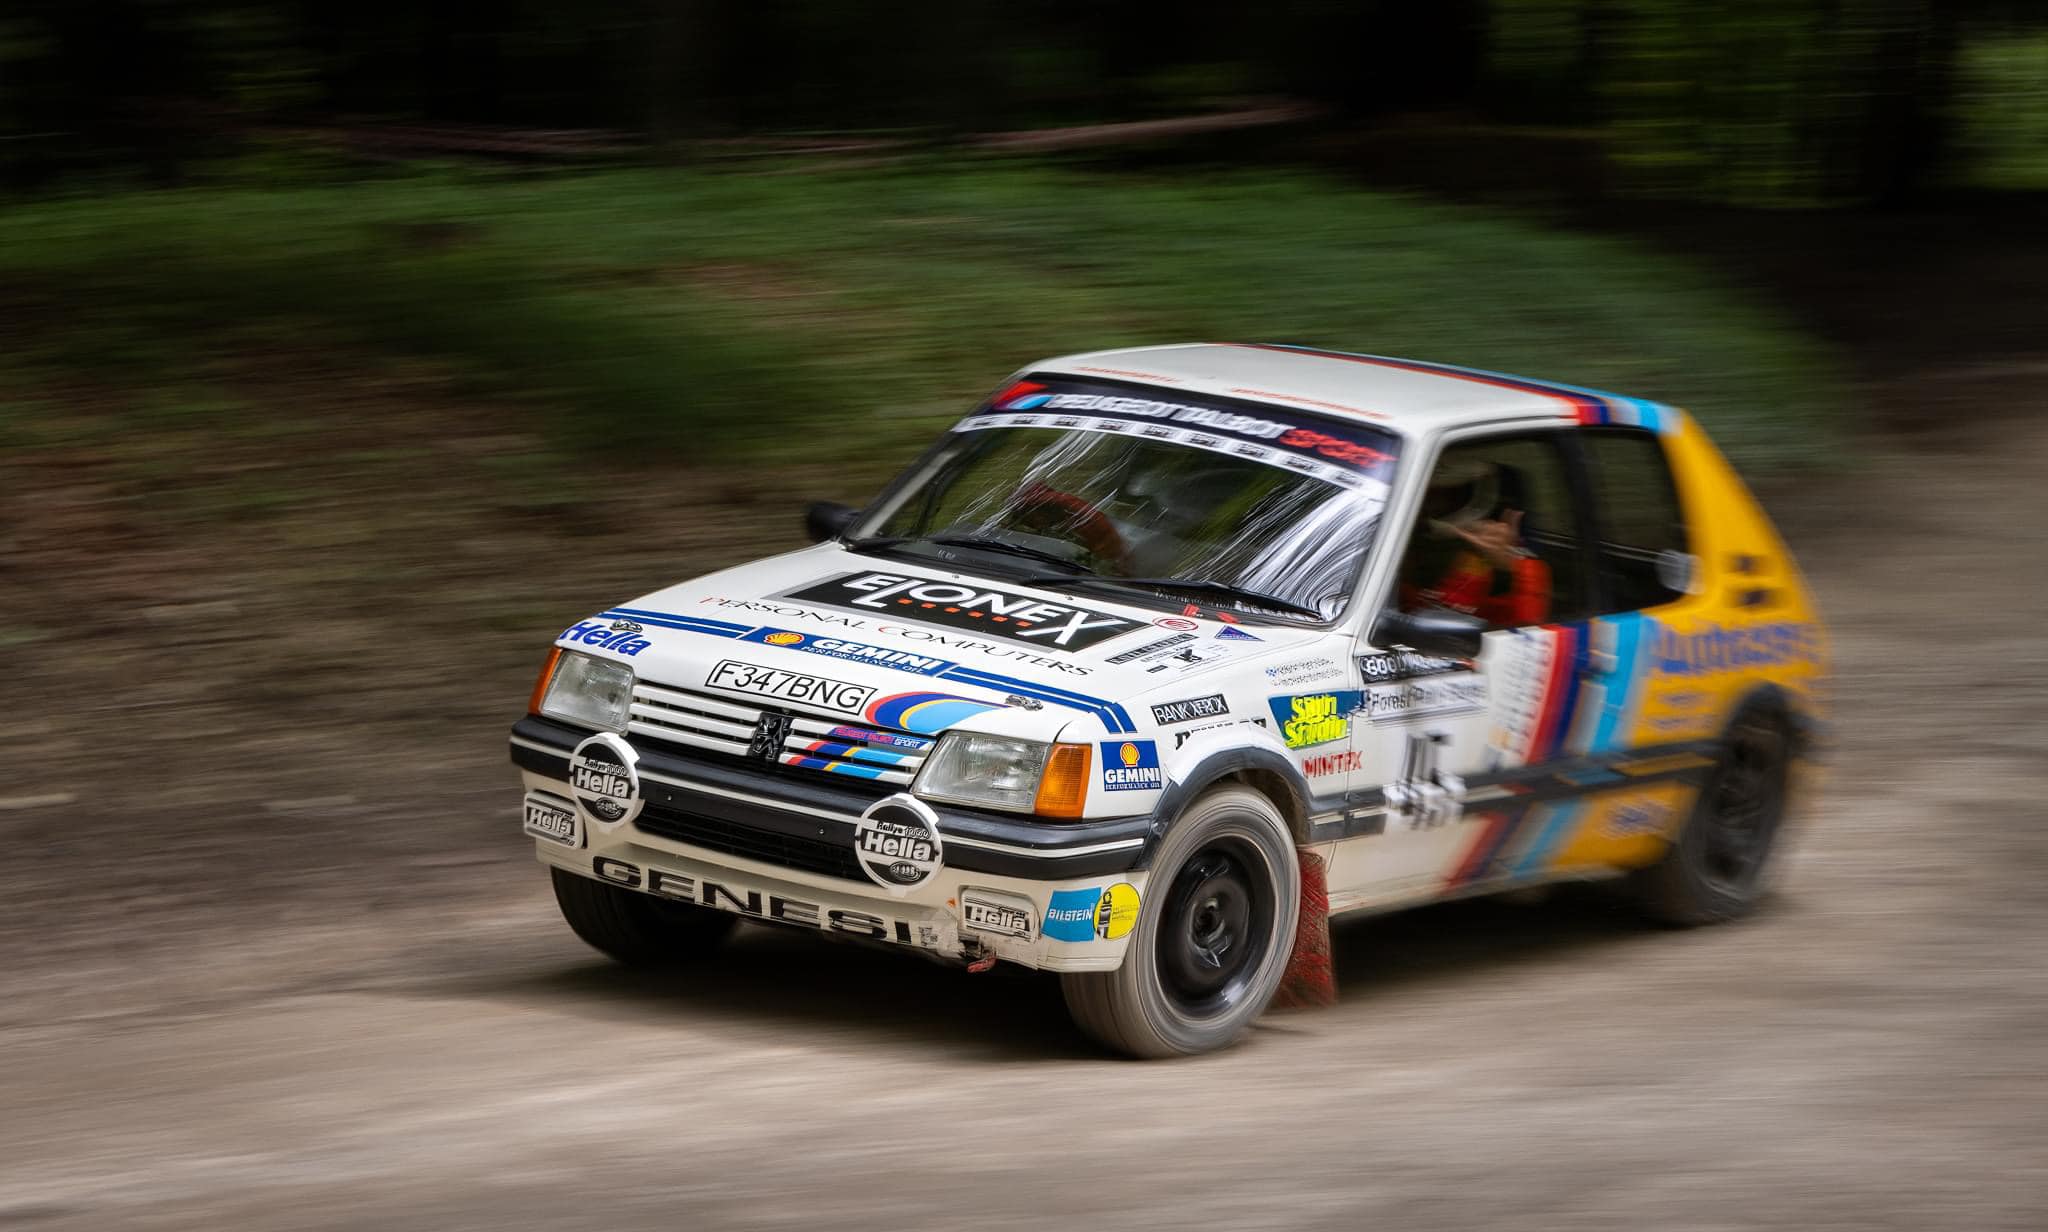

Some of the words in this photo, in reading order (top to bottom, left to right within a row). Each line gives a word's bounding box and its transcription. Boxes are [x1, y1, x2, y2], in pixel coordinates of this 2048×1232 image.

[559, 622, 652, 656] Hella
[699, 597, 867, 630] PERSONAL
[879, 626, 1094, 677] COMPUTERS
[801, 646, 899, 669] PERFORMANCE
[812, 638, 945, 670] GEMINI
[712, 662, 865, 708] F347BNG
[1154, 703, 1191, 722] RANK
[1189, 696, 1228, 716] XEROX
[894, 736, 921, 749] SPORT
[576, 767, 629, 798] Hella
[1104, 767, 1160, 783] GEMINI
[864, 831, 931, 861] Hella
[971, 906, 1026, 931] Hella
[1048, 908, 1093, 921] BILSTEIN
